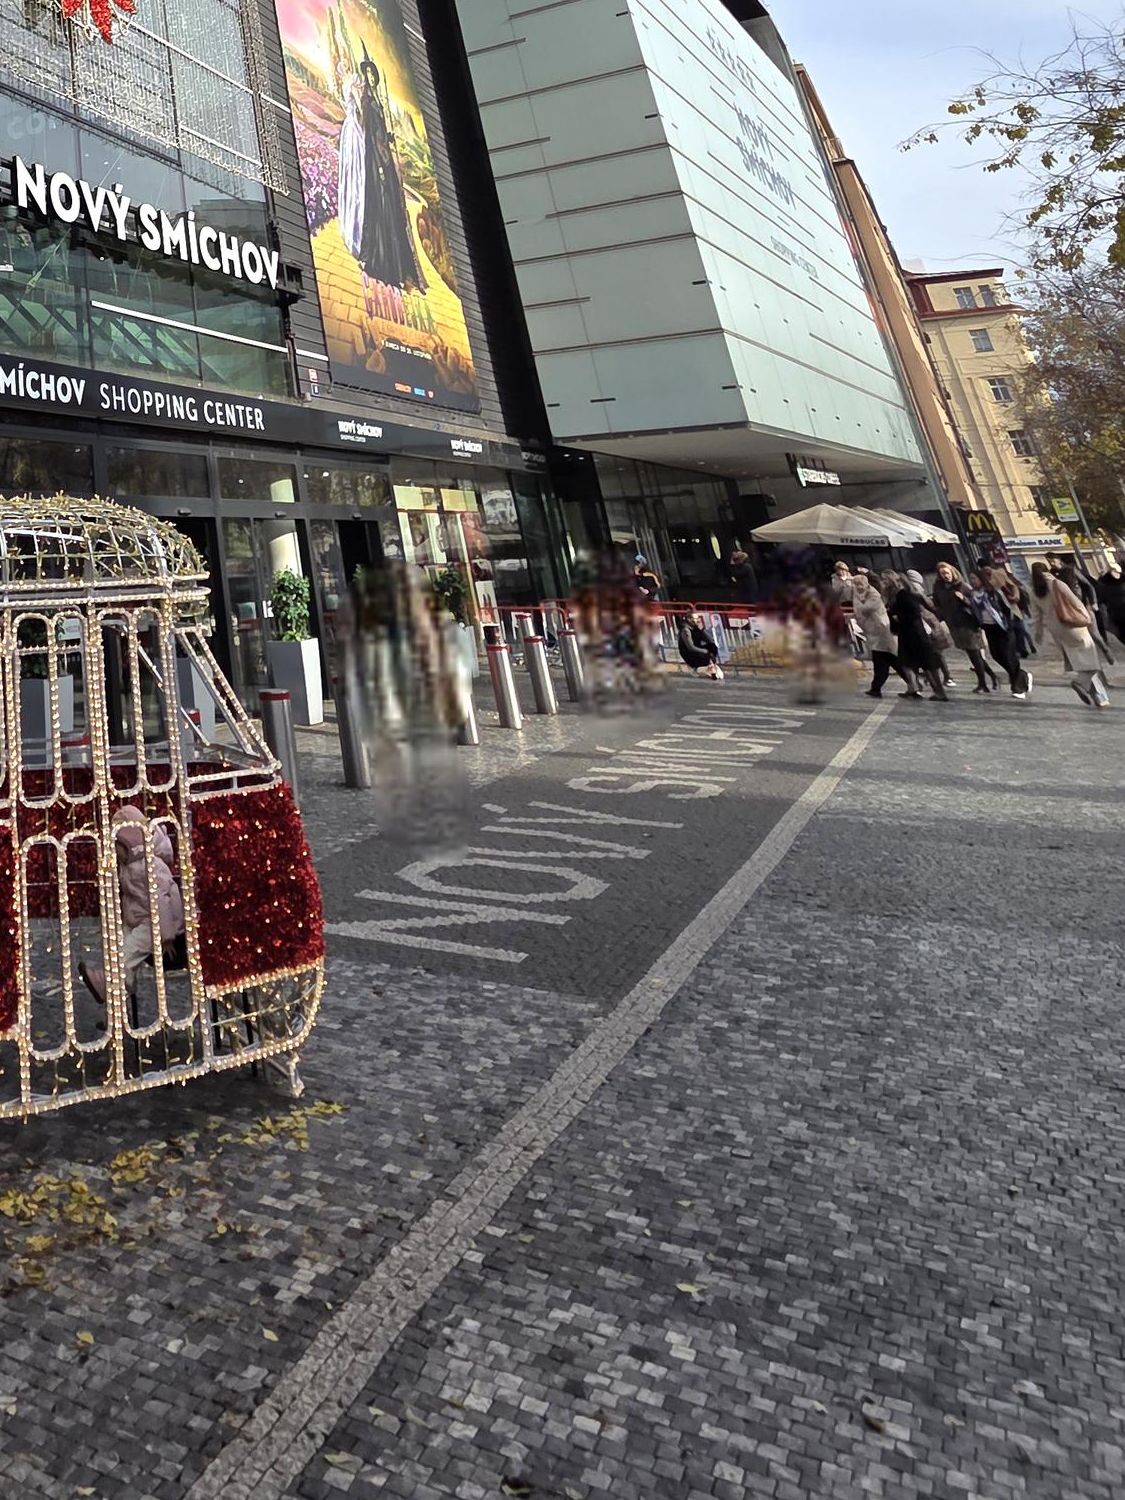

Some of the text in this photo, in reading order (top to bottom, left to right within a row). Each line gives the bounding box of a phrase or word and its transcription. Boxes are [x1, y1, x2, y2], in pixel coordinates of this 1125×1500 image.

[14, 155, 279, 290] NOVÝ SMÍCHOV
[100, 382, 198, 422] SHOPPING
[203, 398, 266, 431] CENTER
[564, 702, 817, 800] SMÍCHOV
[324, 800, 685, 963] NOVÝ
